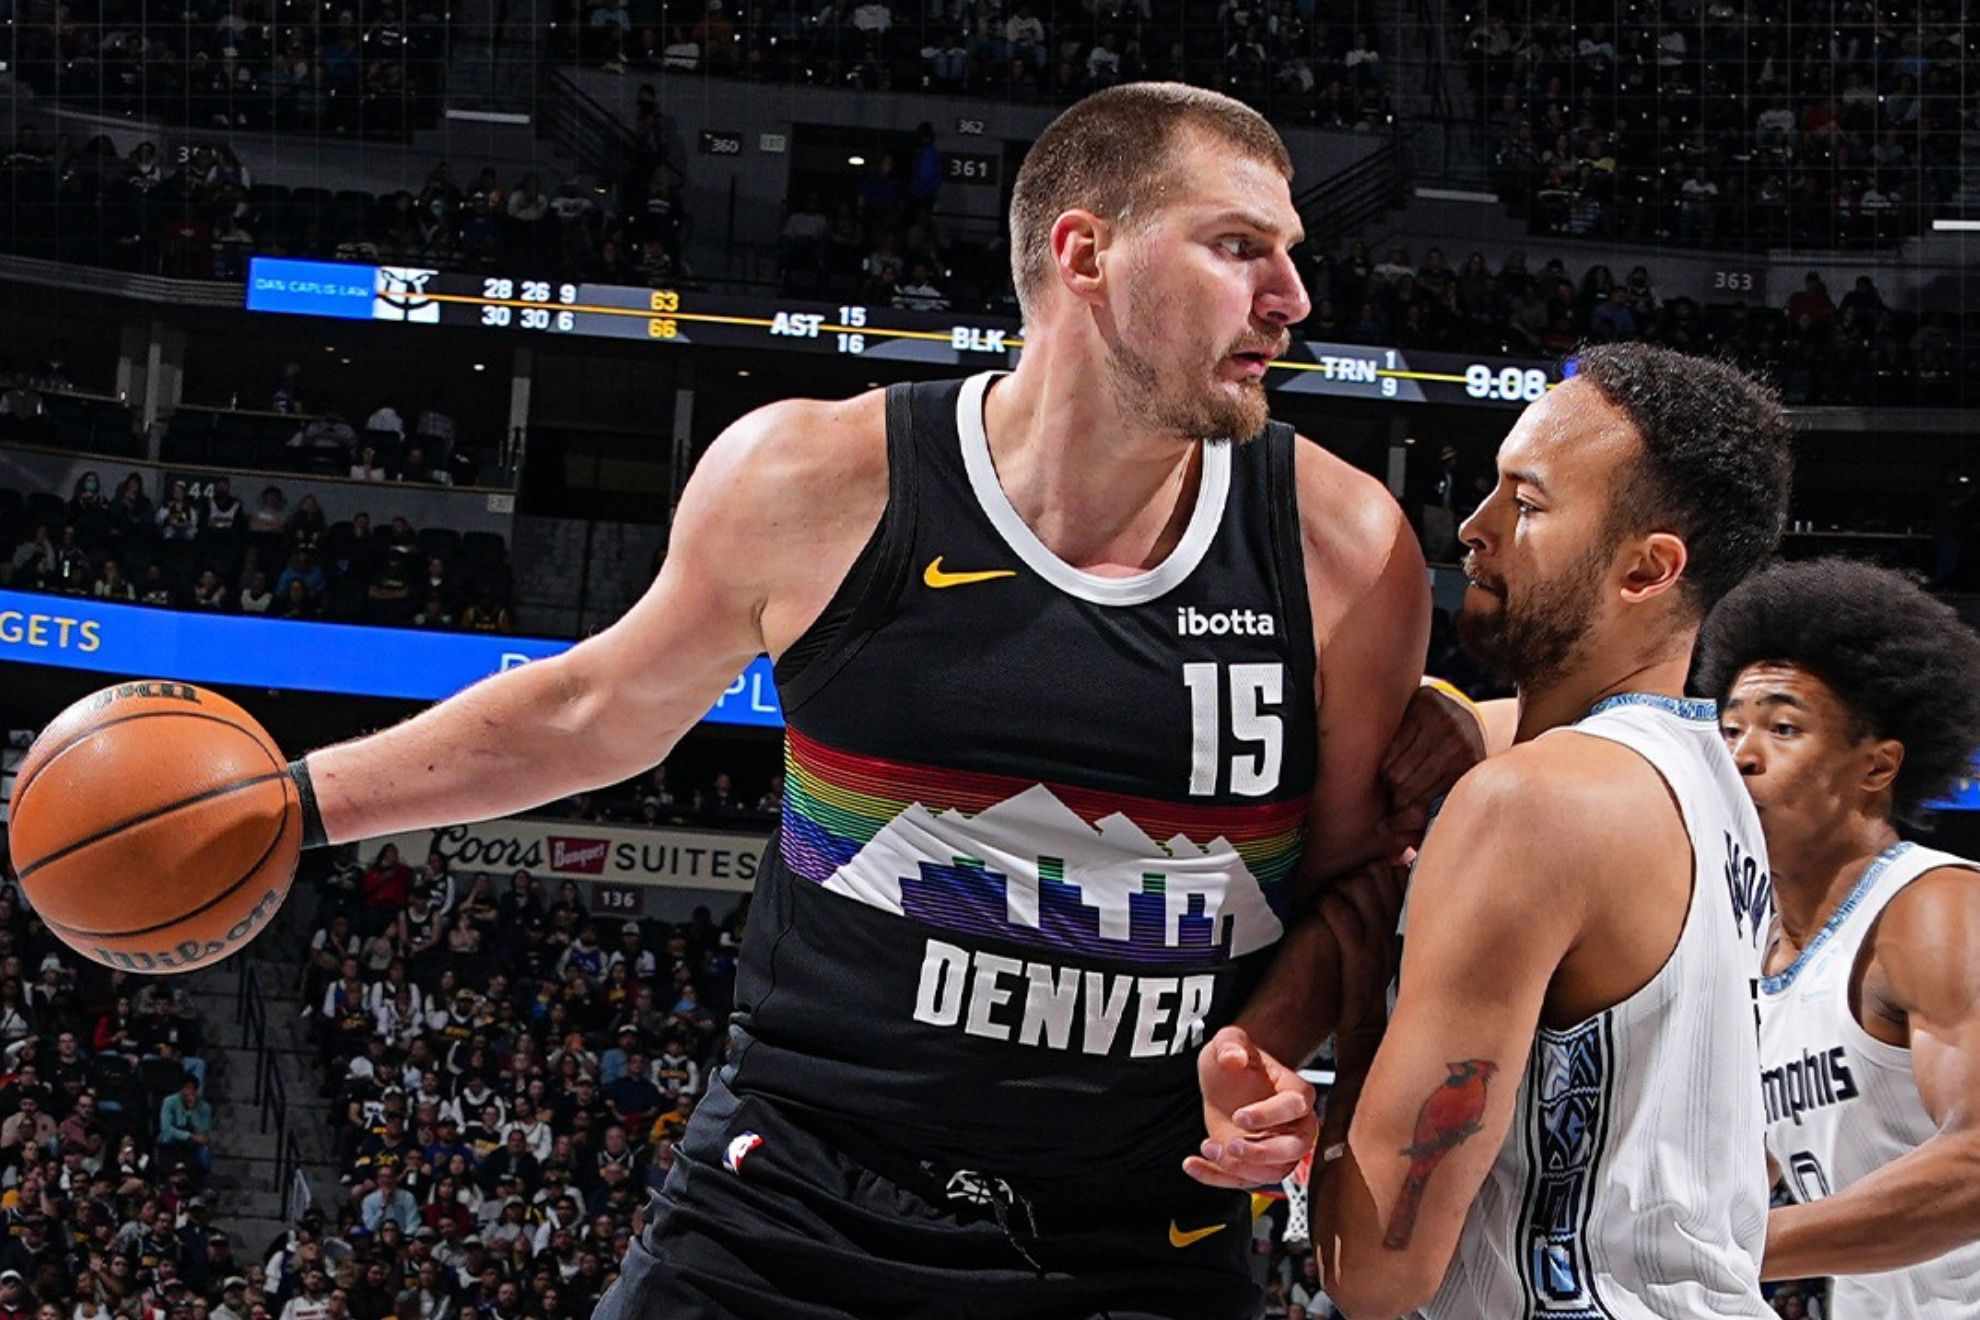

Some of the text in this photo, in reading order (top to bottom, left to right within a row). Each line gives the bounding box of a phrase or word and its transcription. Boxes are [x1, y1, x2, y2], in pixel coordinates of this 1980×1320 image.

[959, 119, 984, 134] 362
[950, 159, 987, 177] 361
[1714, 271, 1753, 290] 363
[483, 277, 679, 312] 28 26 9 63
[481, 305, 511, 328] 30
[520, 308, 550, 330] 30
[557, 312, 574, 331] 6
[770, 312, 824, 338] AST
[839, 306, 867, 327] 15
[837, 333, 864, 354] 16
[951, 327, 1006, 353] BLK
[1320, 356, 1377, 382] TRN
[1385, 351, 1396, 370] 1
[1381, 378, 1398, 397] 9
[1465, 364, 1548, 402] 9:08
[1177, 607, 1276, 637] ibotta
[1182, 661, 1284, 798] 15
[430, 824, 544, 868] Coors
[615, 843, 758, 881] SUITES
[602, 889, 635, 908] 136
[912, 938, 1216, 1059] DENVER
